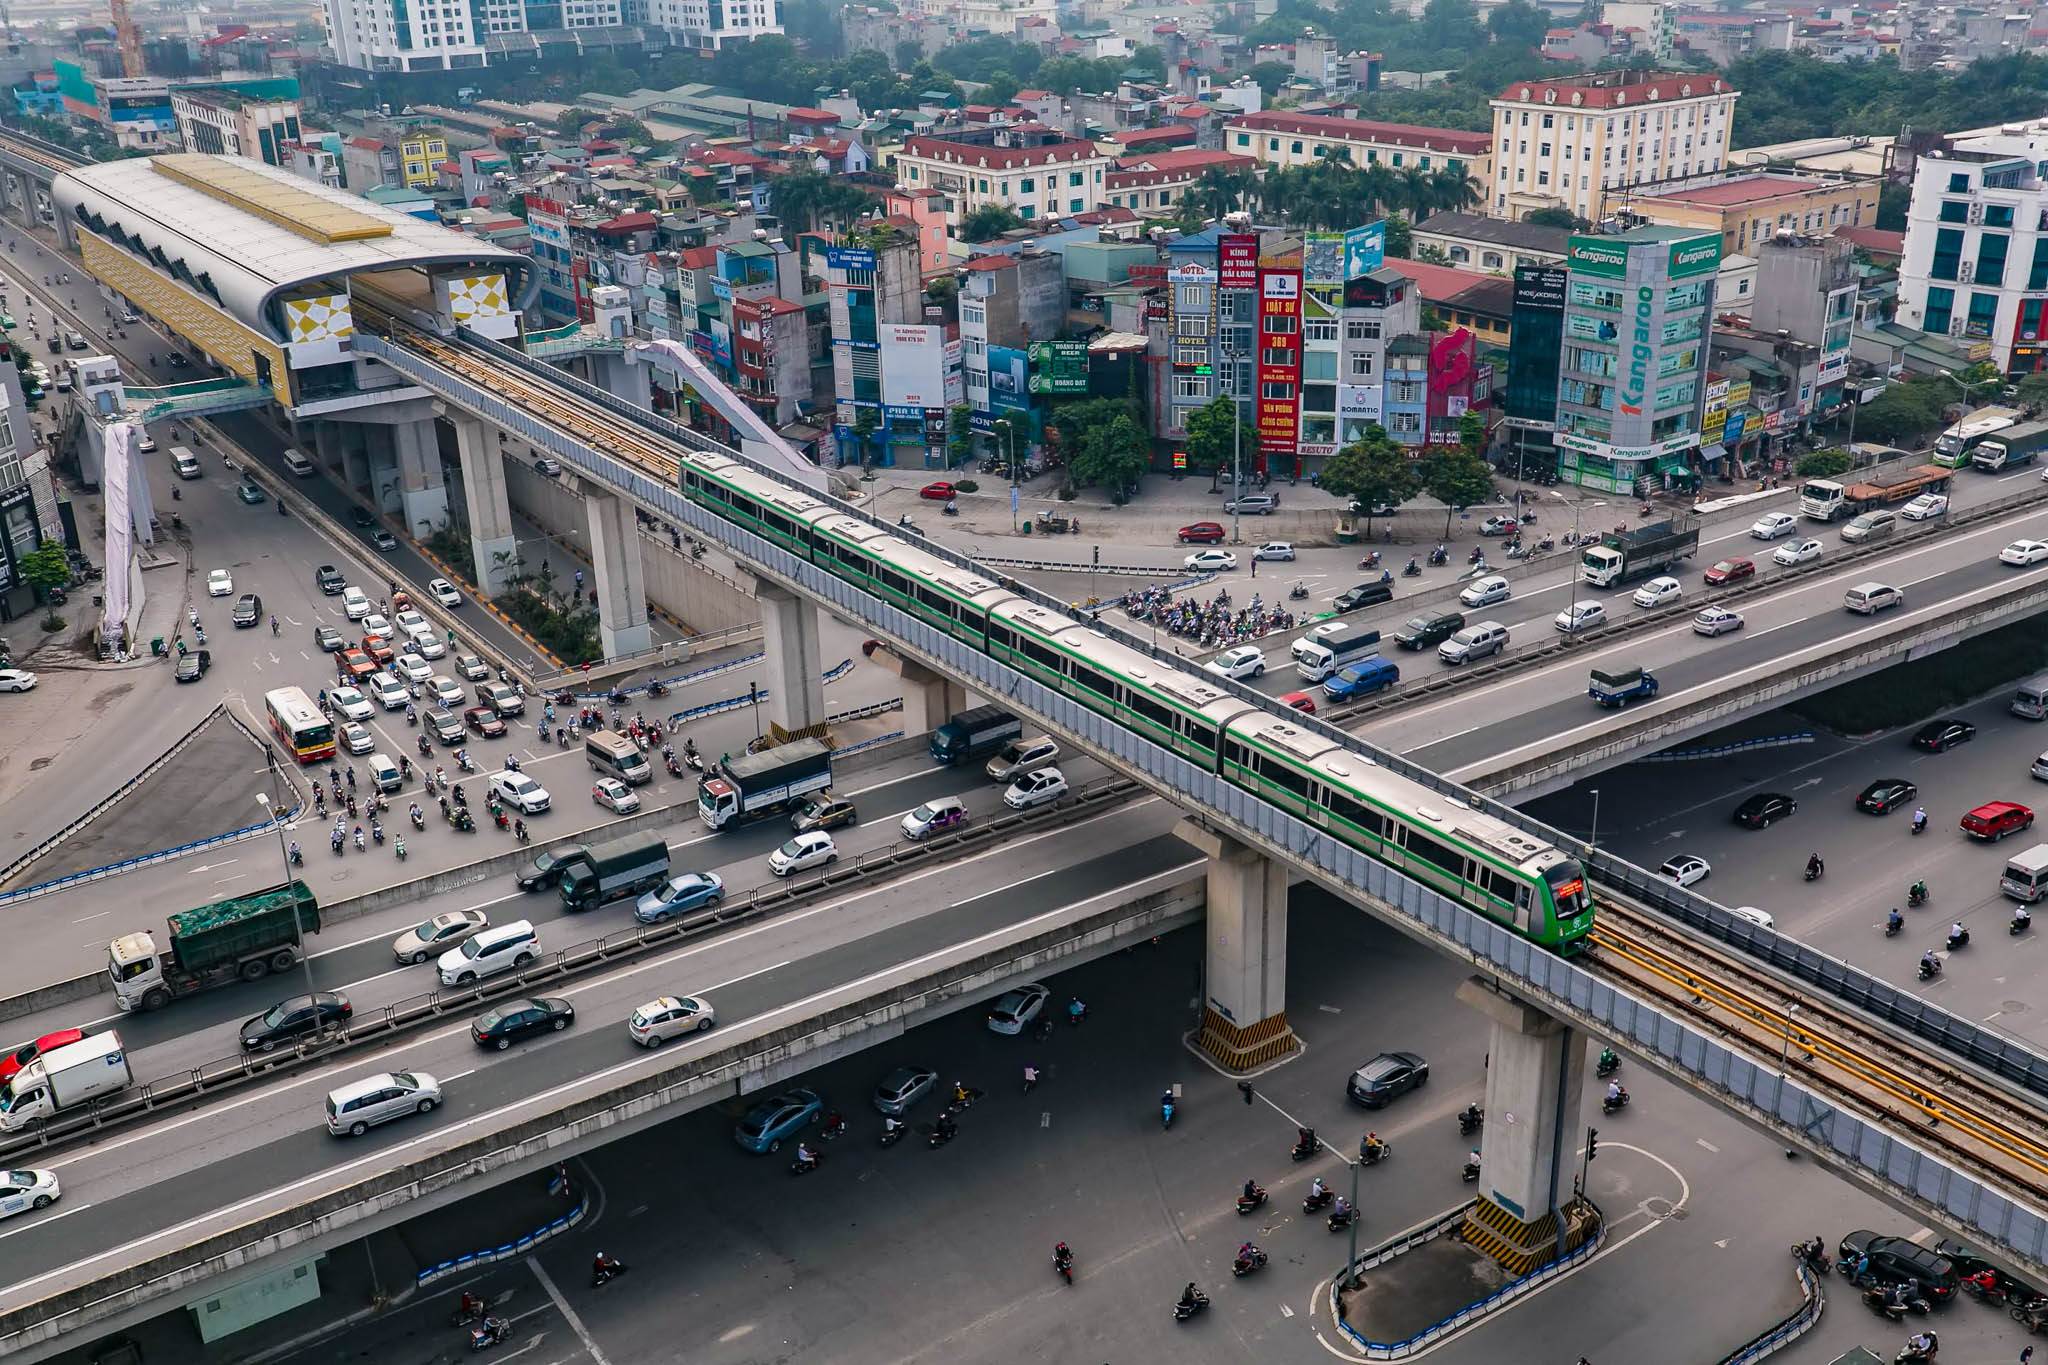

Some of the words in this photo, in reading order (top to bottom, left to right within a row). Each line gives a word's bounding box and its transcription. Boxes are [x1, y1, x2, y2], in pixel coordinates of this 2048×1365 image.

[1229, 248, 1248, 257] KÍNH
[1570, 246, 1624, 265] Kangaroo
[1674, 248, 1717, 265] Kangaroo
[1236, 259, 1255, 267] TOÀN
[1181, 266, 1205, 275] HOTEL
[1236, 270, 1256, 278] LONG
[1149, 300, 1167, 308] Club
[1266, 300, 1282, 314] LUẬT
[1178, 337, 1206, 345] HOTEL
[1620, 286, 1653, 416] Kangaroo
[1562, 435, 1597, 451] Kangaroo
[1662, 438, 1690, 452] Kangaroo
[1610, 447, 1651, 458] Kangaroo
